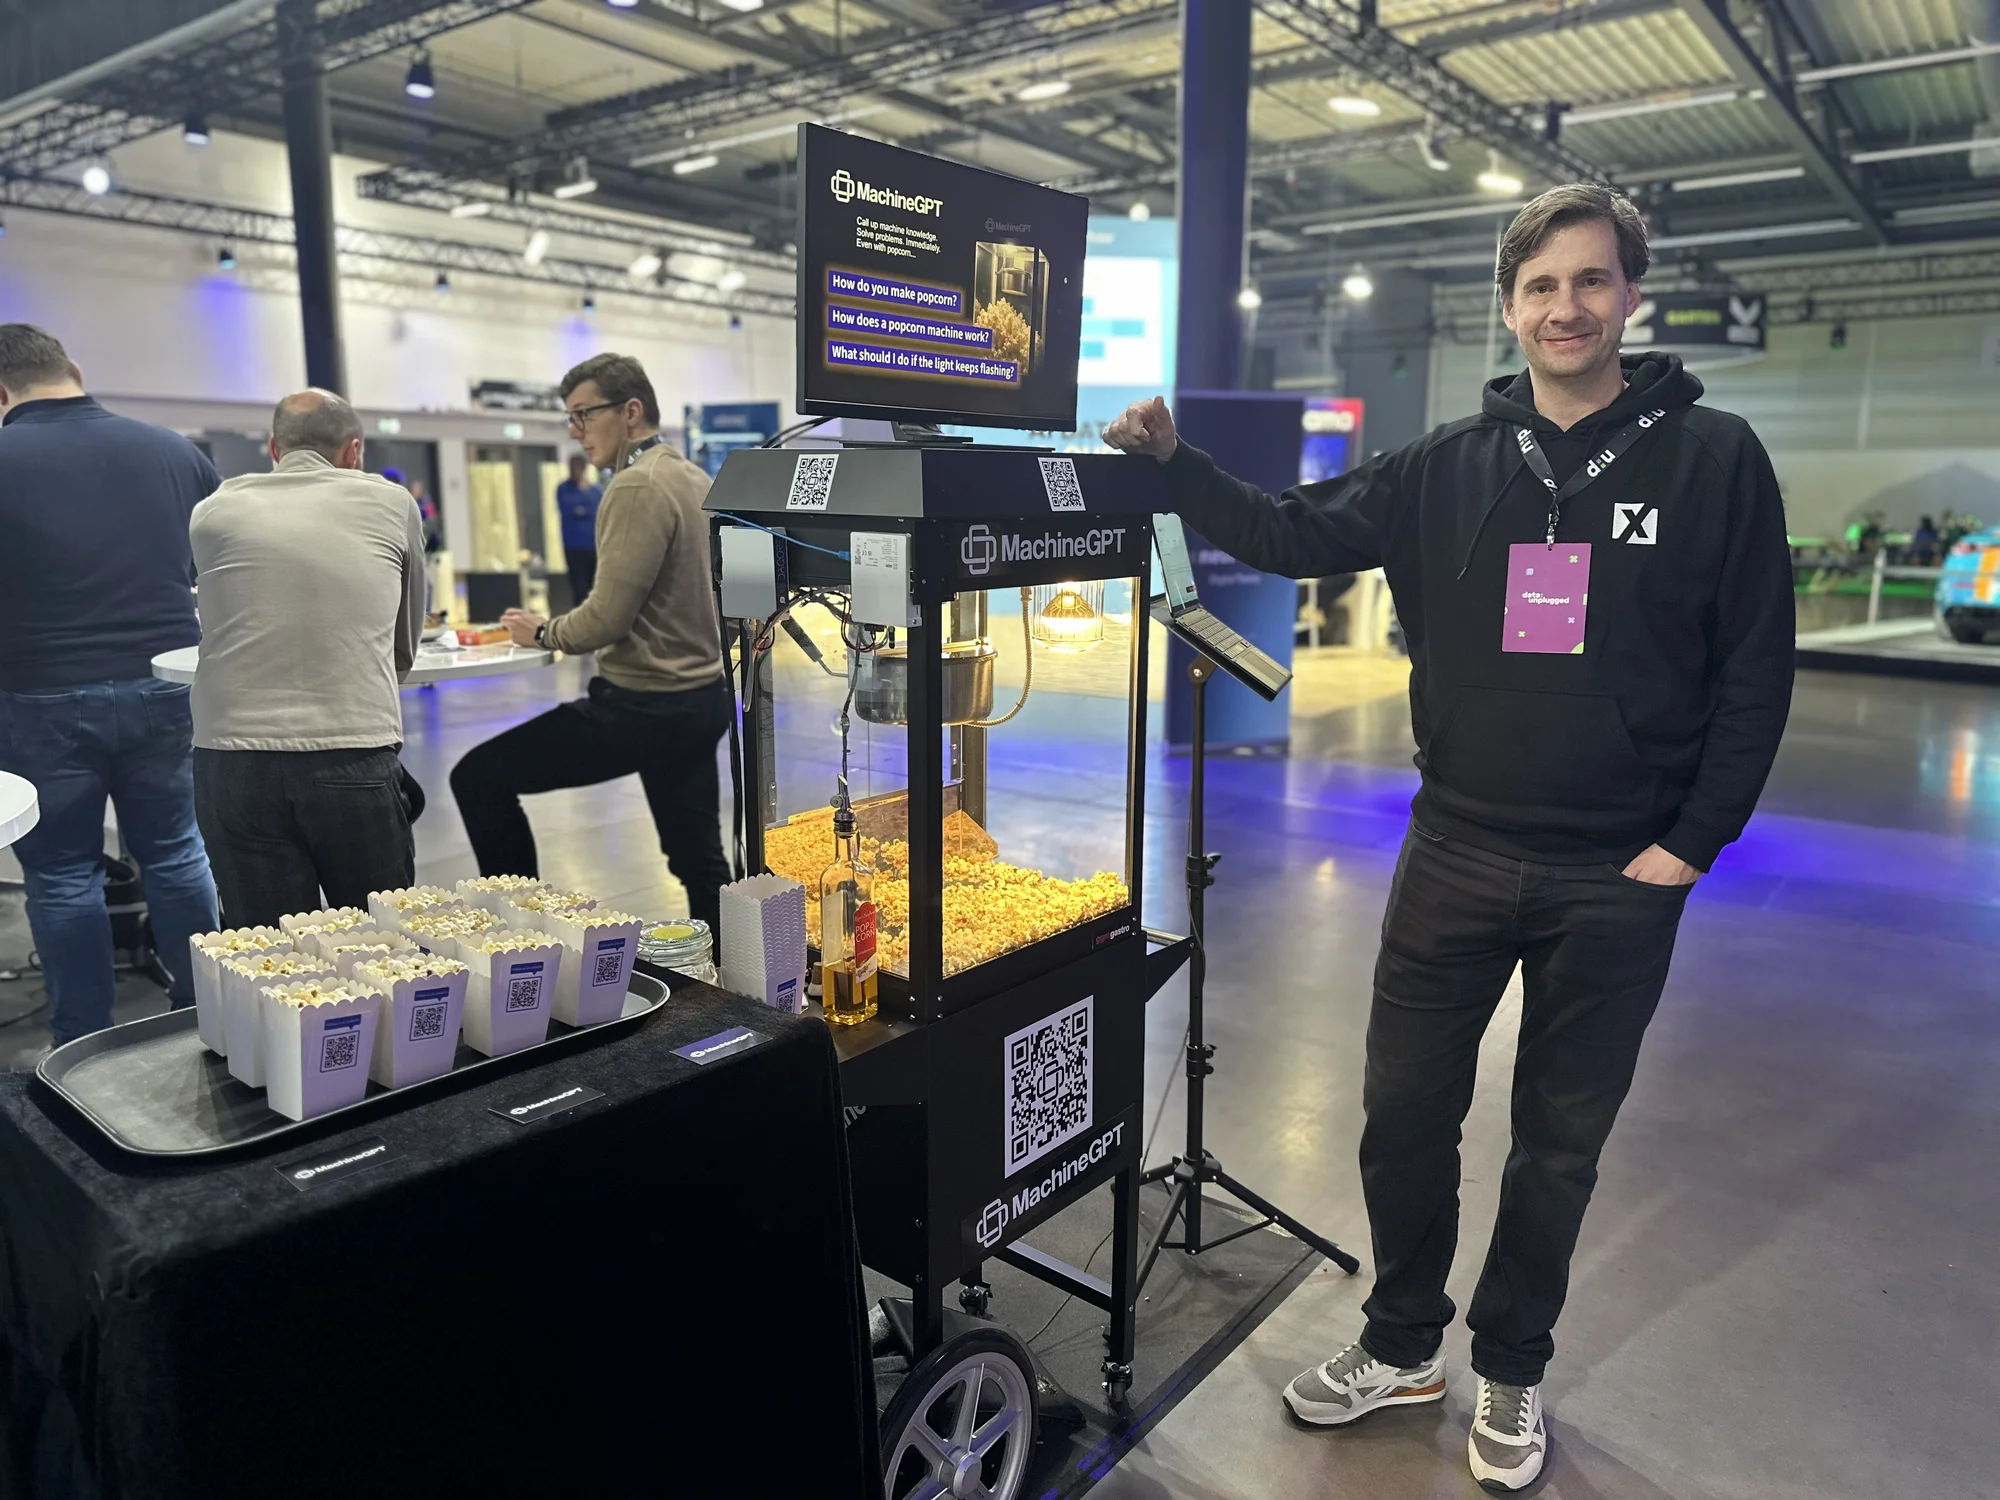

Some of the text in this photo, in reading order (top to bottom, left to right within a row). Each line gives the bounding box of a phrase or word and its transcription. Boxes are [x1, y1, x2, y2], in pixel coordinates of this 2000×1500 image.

[857, 181, 943, 217] MachineGPT
[856, 216, 938, 242] Call up machine knowledge.
[856, 227, 941, 254] Solve problems. Immediately.
[996, 222, 1031, 232] MachineGPT
[856, 238, 872, 249] Even
[873, 242, 886, 252] with
[833, 274, 957, 307] How do you make popcorn?
[832, 309, 989, 343] How does a popcorn machine work?
[831, 345, 1015, 380] What should I do if the light keeps flashing?
[1587, 449, 1616, 477] d:u
[1001, 528, 1126, 562] MachineGPT
[1528, 597, 1570, 605] unplugged
[856, 921, 869, 934] POP
[856, 929, 875, 942] CORN
[1110, 925, 1130, 940] gastro
[315, 1145, 385, 1172] MachineGPT
[1012, 1122, 1125, 1220] MachineGPT
